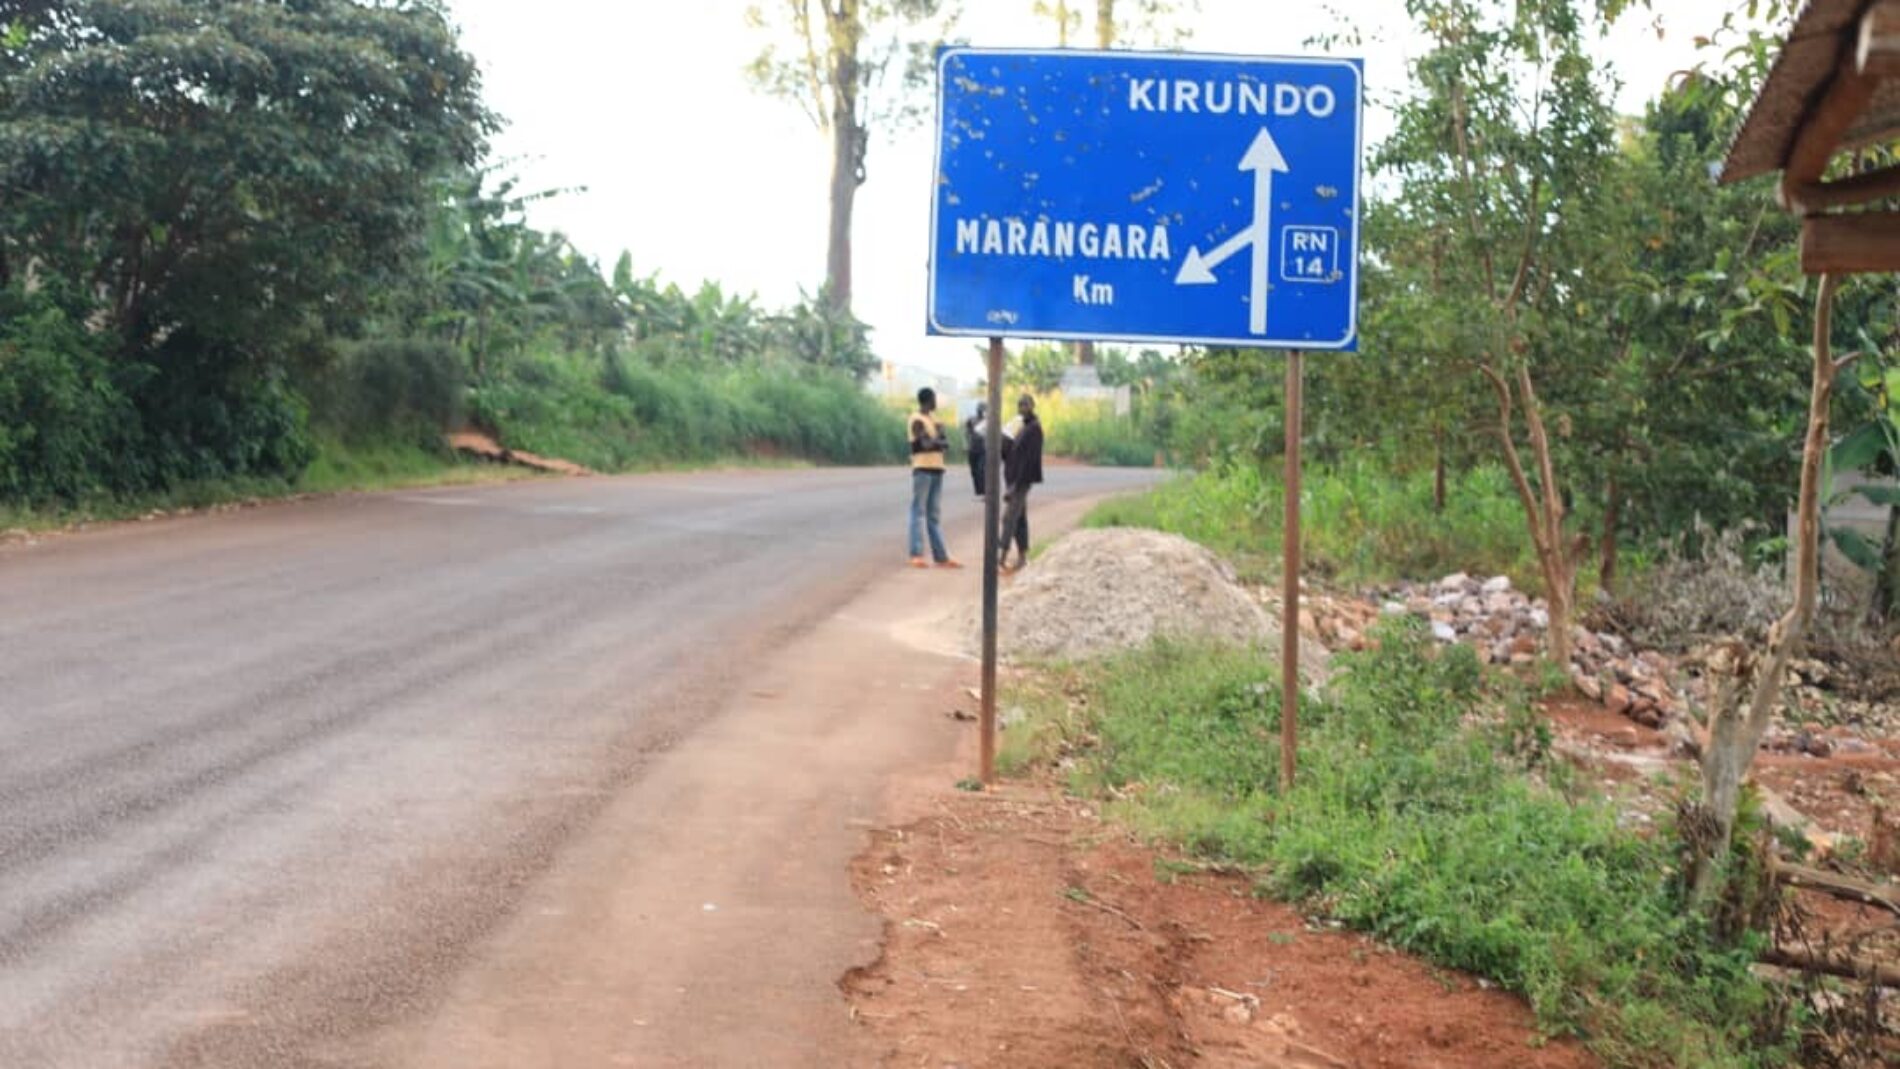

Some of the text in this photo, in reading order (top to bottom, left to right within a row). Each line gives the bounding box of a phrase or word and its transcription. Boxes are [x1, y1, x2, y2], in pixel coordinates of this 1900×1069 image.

[1129, 79, 1335, 117] KIRUNDO
[956, 219, 1170, 259] MARANGARA
[1293, 232, 1327, 252] RN
[1295, 256, 1323, 276] 14
[1073, 275, 1113, 304] Km
